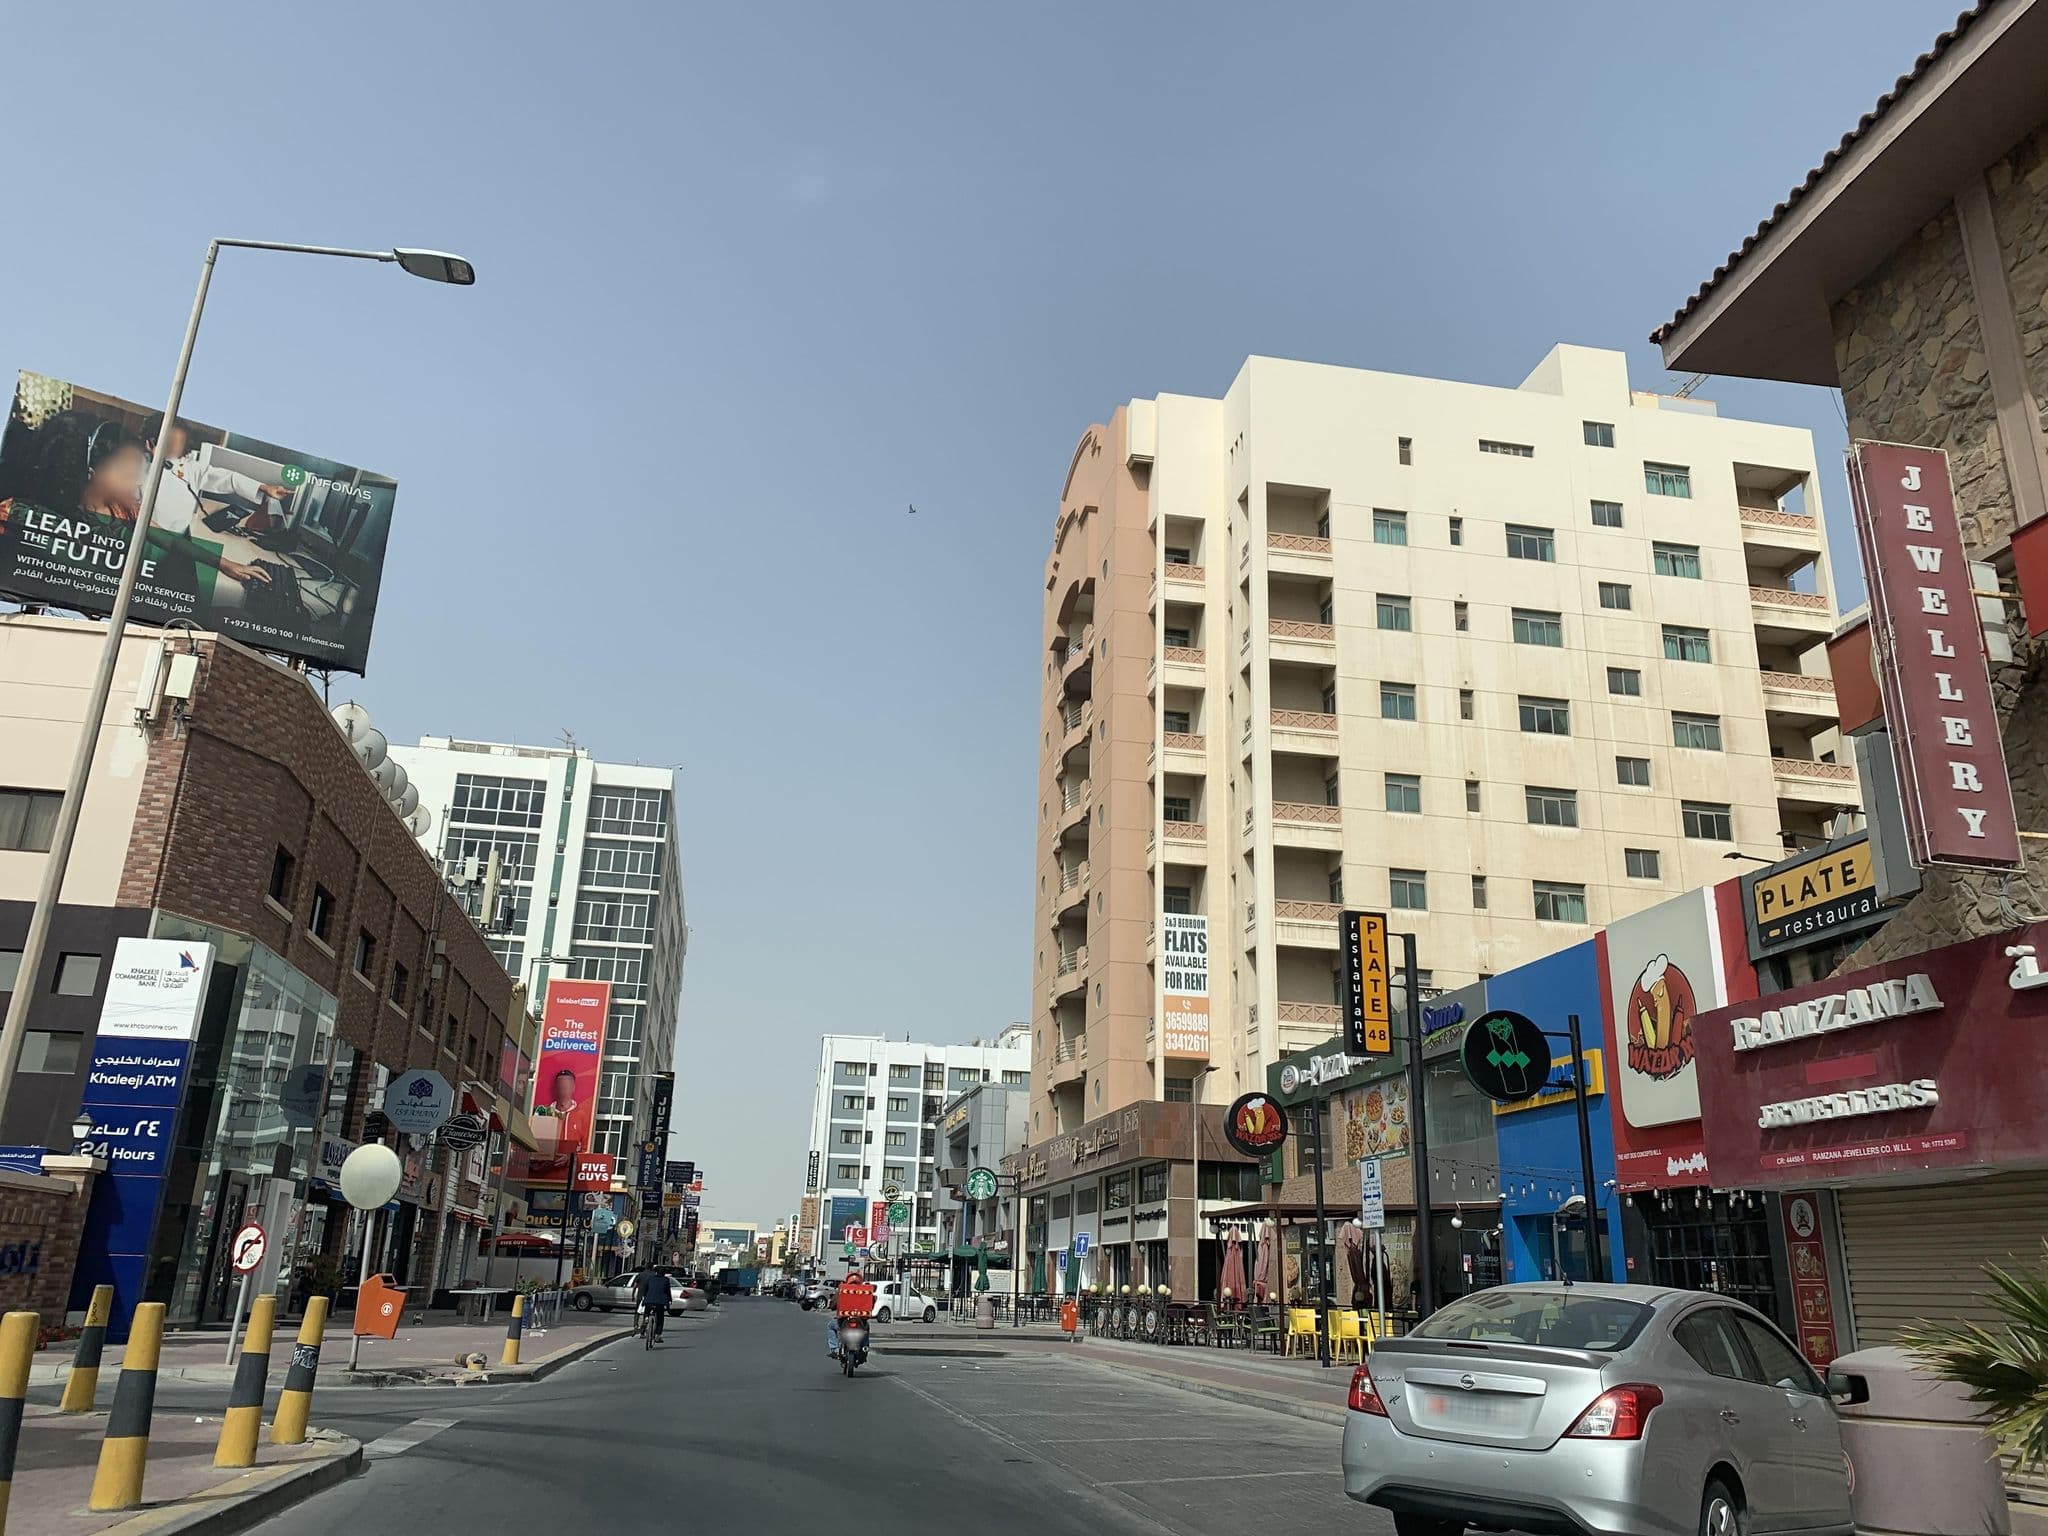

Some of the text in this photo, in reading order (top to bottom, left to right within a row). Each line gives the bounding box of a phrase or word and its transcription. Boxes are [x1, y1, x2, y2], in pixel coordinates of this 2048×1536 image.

[307, 472, 372, 500] INFONAS
[24, 509, 126, 550] LEAP INTO
[22, 530, 157, 578] THE FUTUE
[12, 568, 43, 580] القادم
[17, 554, 45, 568] WITH
[45, 561, 66, 573] OUR
[67, 566, 93, 579] NEXT
[94, 572, 153, 593] GENEION
[154, 586, 196, 602] SERVICES
[230, 619, 249, 629] +973
[252, 623, 261, 631] 16
[262, 626, 278, 635] 500
[279, 628, 293, 638] 100
[301, 634, 345, 650] infonas.com
[1901, 465, 1987, 838] JEWELLERY
[1761, 858, 1858, 915] PLATE
[1178, 917, 1206, 930] BEDROOM
[1164, 930, 1207, 954] FLATS
[1165, 955, 1207, 969] AVAILABLE
[1366, 921, 1382, 1013] PLATE
[115, 973, 157, 981] COMMERCIAL
[1165, 971, 1207, 991] FOR RENT
[1350, 920, 1363, 1044] restaurant
[1165, 1011, 1208, 1032] 36599889
[1420, 1003, 1464, 1036] Sumo
[1730, 973, 1944, 1051] RAMZANA
[547, 1027, 598, 1040] Greatest
[564, 1018, 584, 1029] The
[545, 1038, 597, 1050] Delivered
[1165, 1032, 1209, 1053] 33412611
[1368, 1029, 1386, 1041] 48
[95, 1056, 180, 1068] الصراف الخليجي
[1310, 1051, 1350, 1087] PIZZA
[89, 1072, 176, 1089] Khaleeji ATM
[1758, 1079, 1939, 1129] JEWELLERS
[91, 1120, 161, 1137] ٢٤ ساع
[80, 1141, 156, 1161] 24 Hours
[1812, 1151, 1842, 1161] RAMZANA
[1843, 1147, 1880, 1158] JEWELLERS
[577, 1172, 609, 1181] GUYS
[581, 1163, 607, 1172] FIVE
[643, 1154, 653, 1186] MARKET
